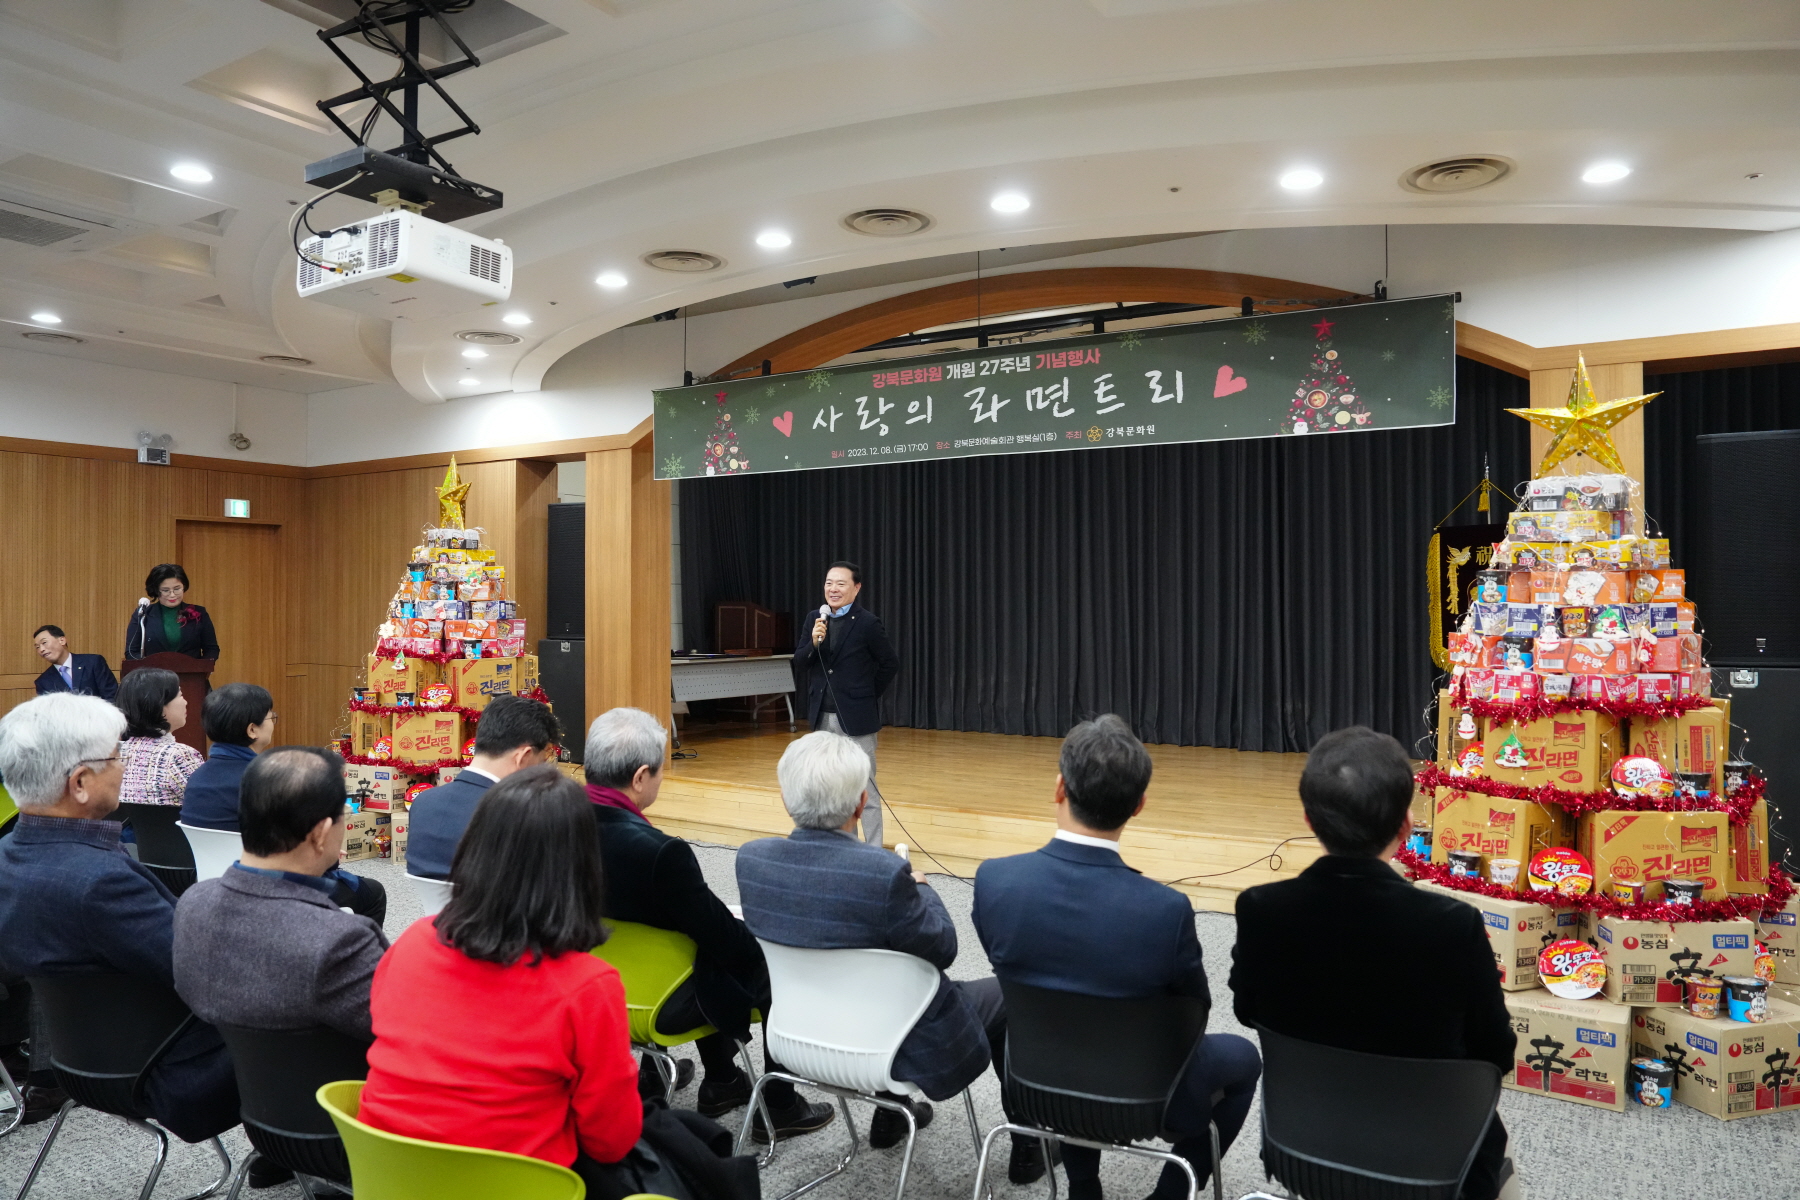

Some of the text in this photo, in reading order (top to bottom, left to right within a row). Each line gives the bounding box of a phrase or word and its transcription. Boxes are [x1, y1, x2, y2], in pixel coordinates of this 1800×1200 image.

[872, 348, 1101, 388] 강북문화원 개원 27주년 기념행사
[812, 395, 932, 437] 사랑의
[831, 450, 845, 459] 일시
[893, 443, 907, 455] (금)
[907, 442, 929, 453] 17:00
[936, 440, 950, 450] 장소
[954, 435, 1015, 449] 강북문화예술회관
[1065, 430, 1082, 440] 주최
[1105, 424, 1155, 438] 강북문화원
[383, 679, 407, 694] 진라면
[415, 735, 450, 750] 진라면
[1522, 746, 1580, 772] 진라면
[1460, 832, 1508, 856] 진라면
[1542, 861, 1581, 882] 왕뚜껑
[1614, 868, 1634, 876] 오뚜기
[1642, 854, 1712, 882] 진라면
[1483, 913, 1506, 929] 멀티팩
[1528, 921, 1543, 931] 농심
[1641, 939, 1668, 950] 농심
[1715, 936, 1746, 947] 멀티팩
[1768, 947, 1796, 957] 라면
[1517, 958, 1535, 966] 가3487
[1551, 951, 1593, 976] 왕뚜껑
[1634, 976, 1656, 984] 가3487
[1646, 1021, 1666, 1036] 농심
[1579, 1030, 1612, 1045] 멀티팩
[1688, 1034, 1715, 1053] 멀티팩
[1579, 1049, 1587, 1057] 신
[1743, 1042, 1765, 1055] 농심
[1525, 1034, 1576, 1092] 辛
[1662, 1042, 1695, 1090] 辛
[1575, 1067, 1609, 1083] 라면
[1694, 1072, 1718, 1089] 라면
[1762, 1047, 1798, 1108] 辛
[1737, 1082, 1754, 1092] 가3487
